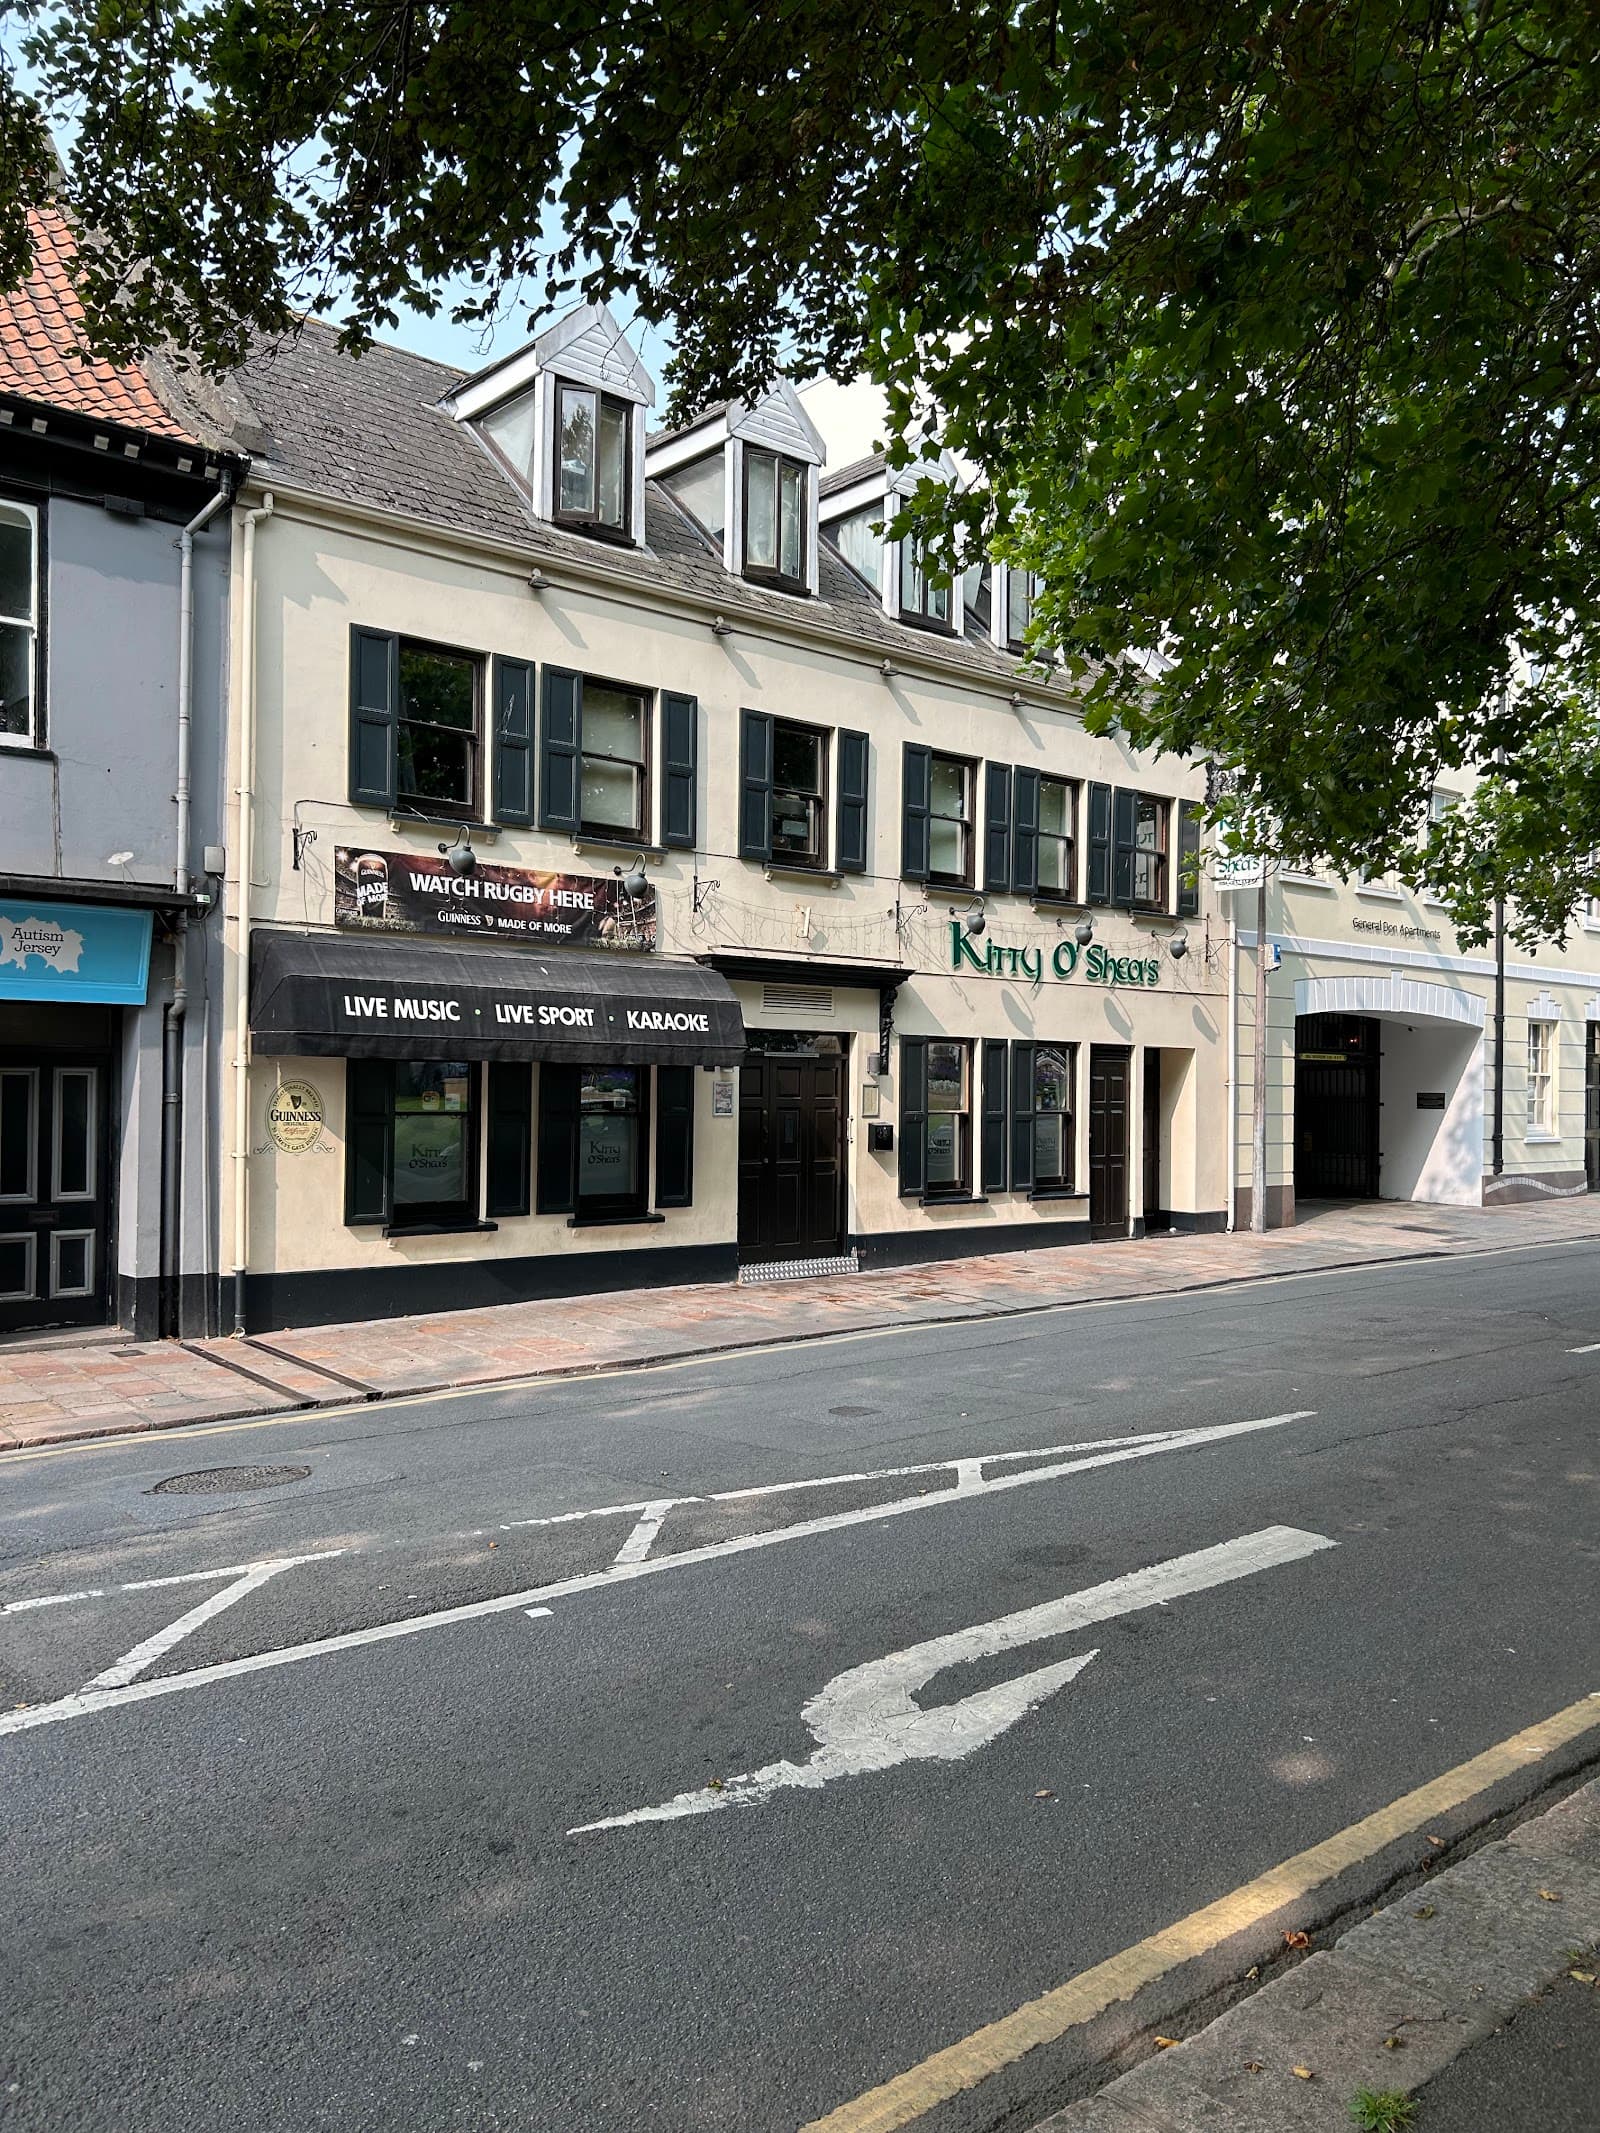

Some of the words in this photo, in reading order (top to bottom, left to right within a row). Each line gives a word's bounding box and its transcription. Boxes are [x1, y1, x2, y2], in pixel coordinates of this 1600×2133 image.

[356, 881, 389, 898] MADE
[409, 872, 479, 898] WATCH
[484, 881, 545, 905] RUGBY
[549, 889, 595, 910] HERE
[356, 896, 366, 906] OF
[367, 893, 389, 903] MORE
[437, 910, 482, 926] GUINNESS
[498, 918, 527, 930] MADE
[528, 920, 542, 931] OF
[543, 922, 573, 934] MORE
[1352, 917, 1382, 931] General
[1400, 924, 1441, 940] Apartments
[11, 927, 65, 942] Autism
[14, 940, 61, 957] Jersey
[344, 995, 387, 1018] LIVE
[393, 998, 461, 1021] MUSIC
[495, 1004, 534, 1024] LIVE
[538, 1005, 595, 1027] SPORT
[626, 1010, 710, 1032] KARAOKE
[270, 1109, 322, 1122] GUINNESS
